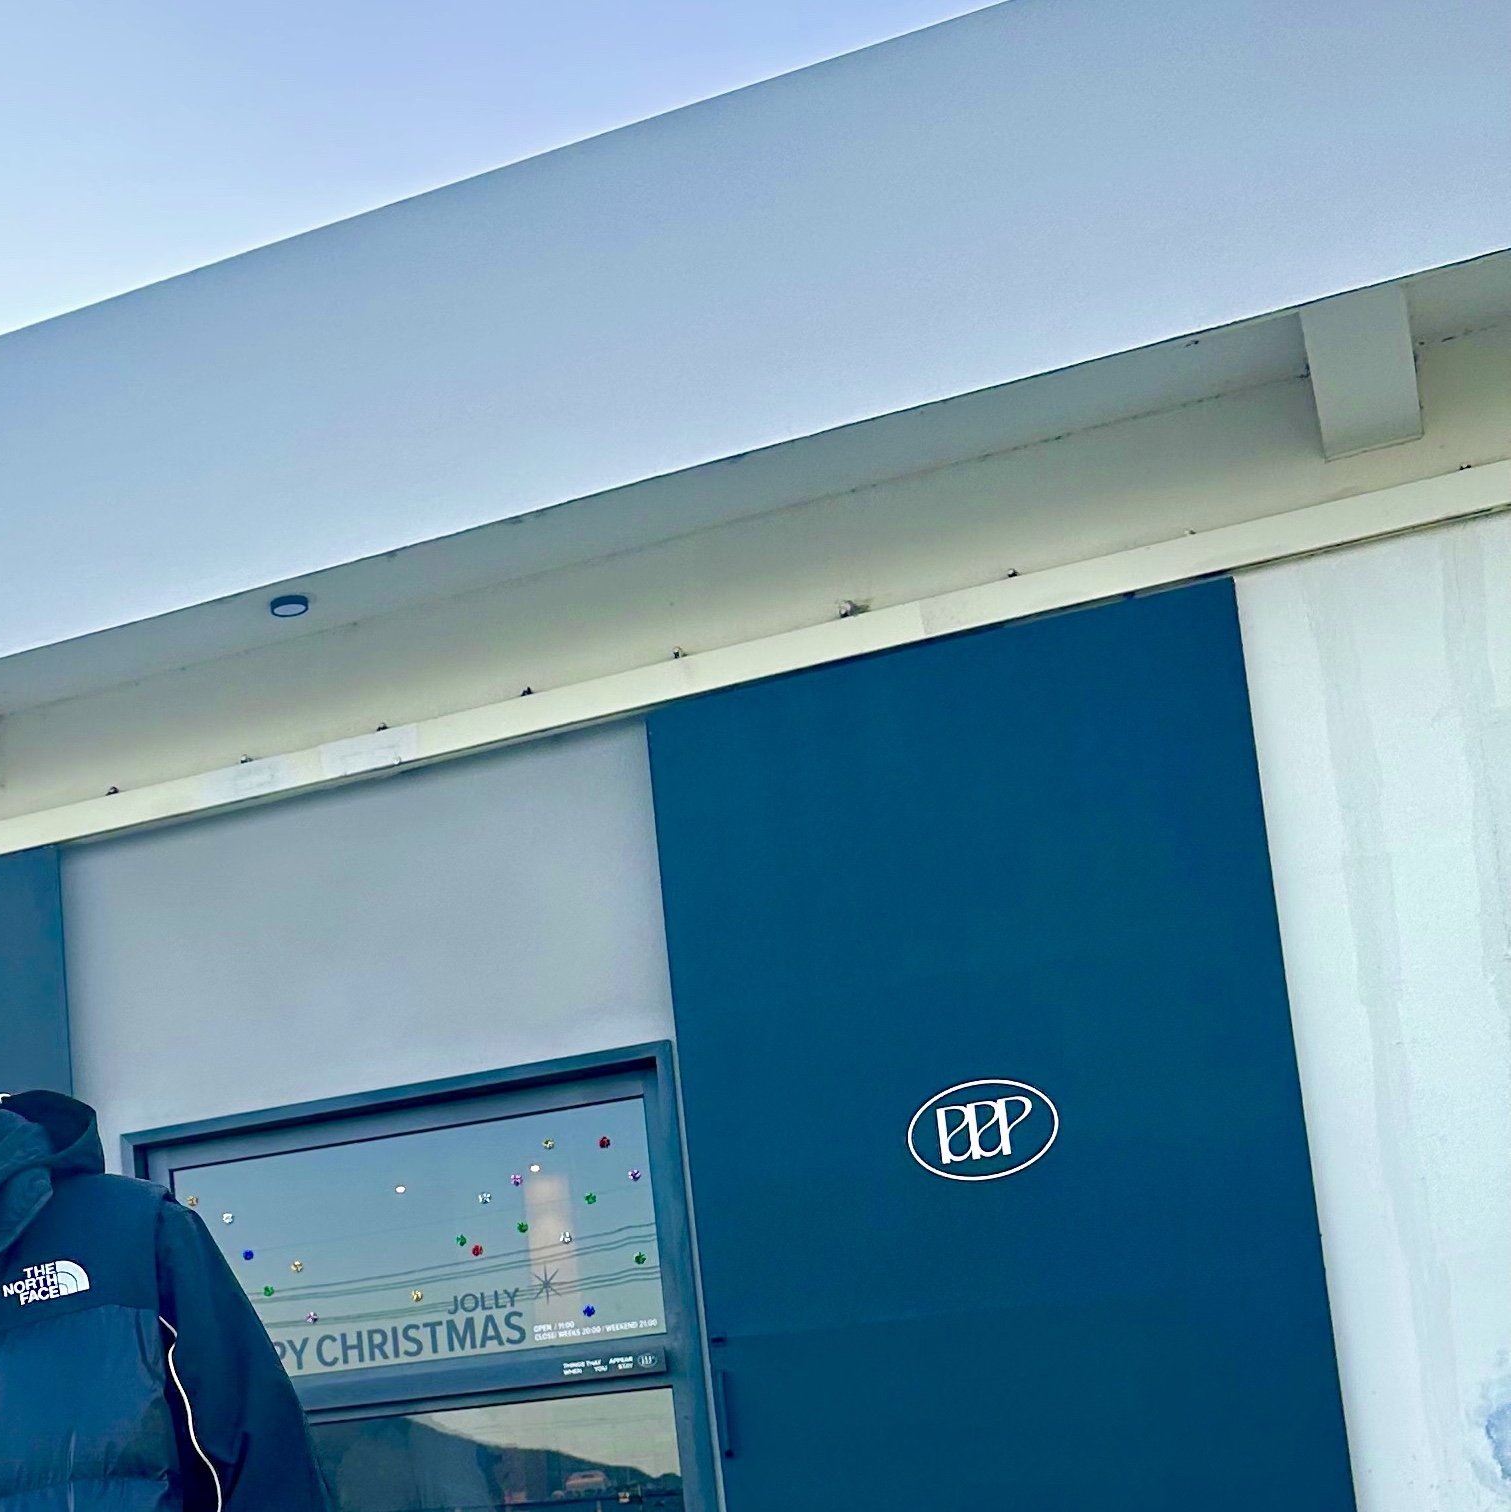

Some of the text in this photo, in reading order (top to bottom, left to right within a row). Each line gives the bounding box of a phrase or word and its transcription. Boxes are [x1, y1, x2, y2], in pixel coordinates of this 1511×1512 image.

[23, 1262, 55, 1279] THE
[2, 1274, 58, 1298] NORTH
[20, 1286, 61, 1306] FACE
[448, 1288, 519, 1315] JOLLY
[534, 1323, 552, 1332] OPEN
[316, 1311, 526, 1367] CHRISTMAS
